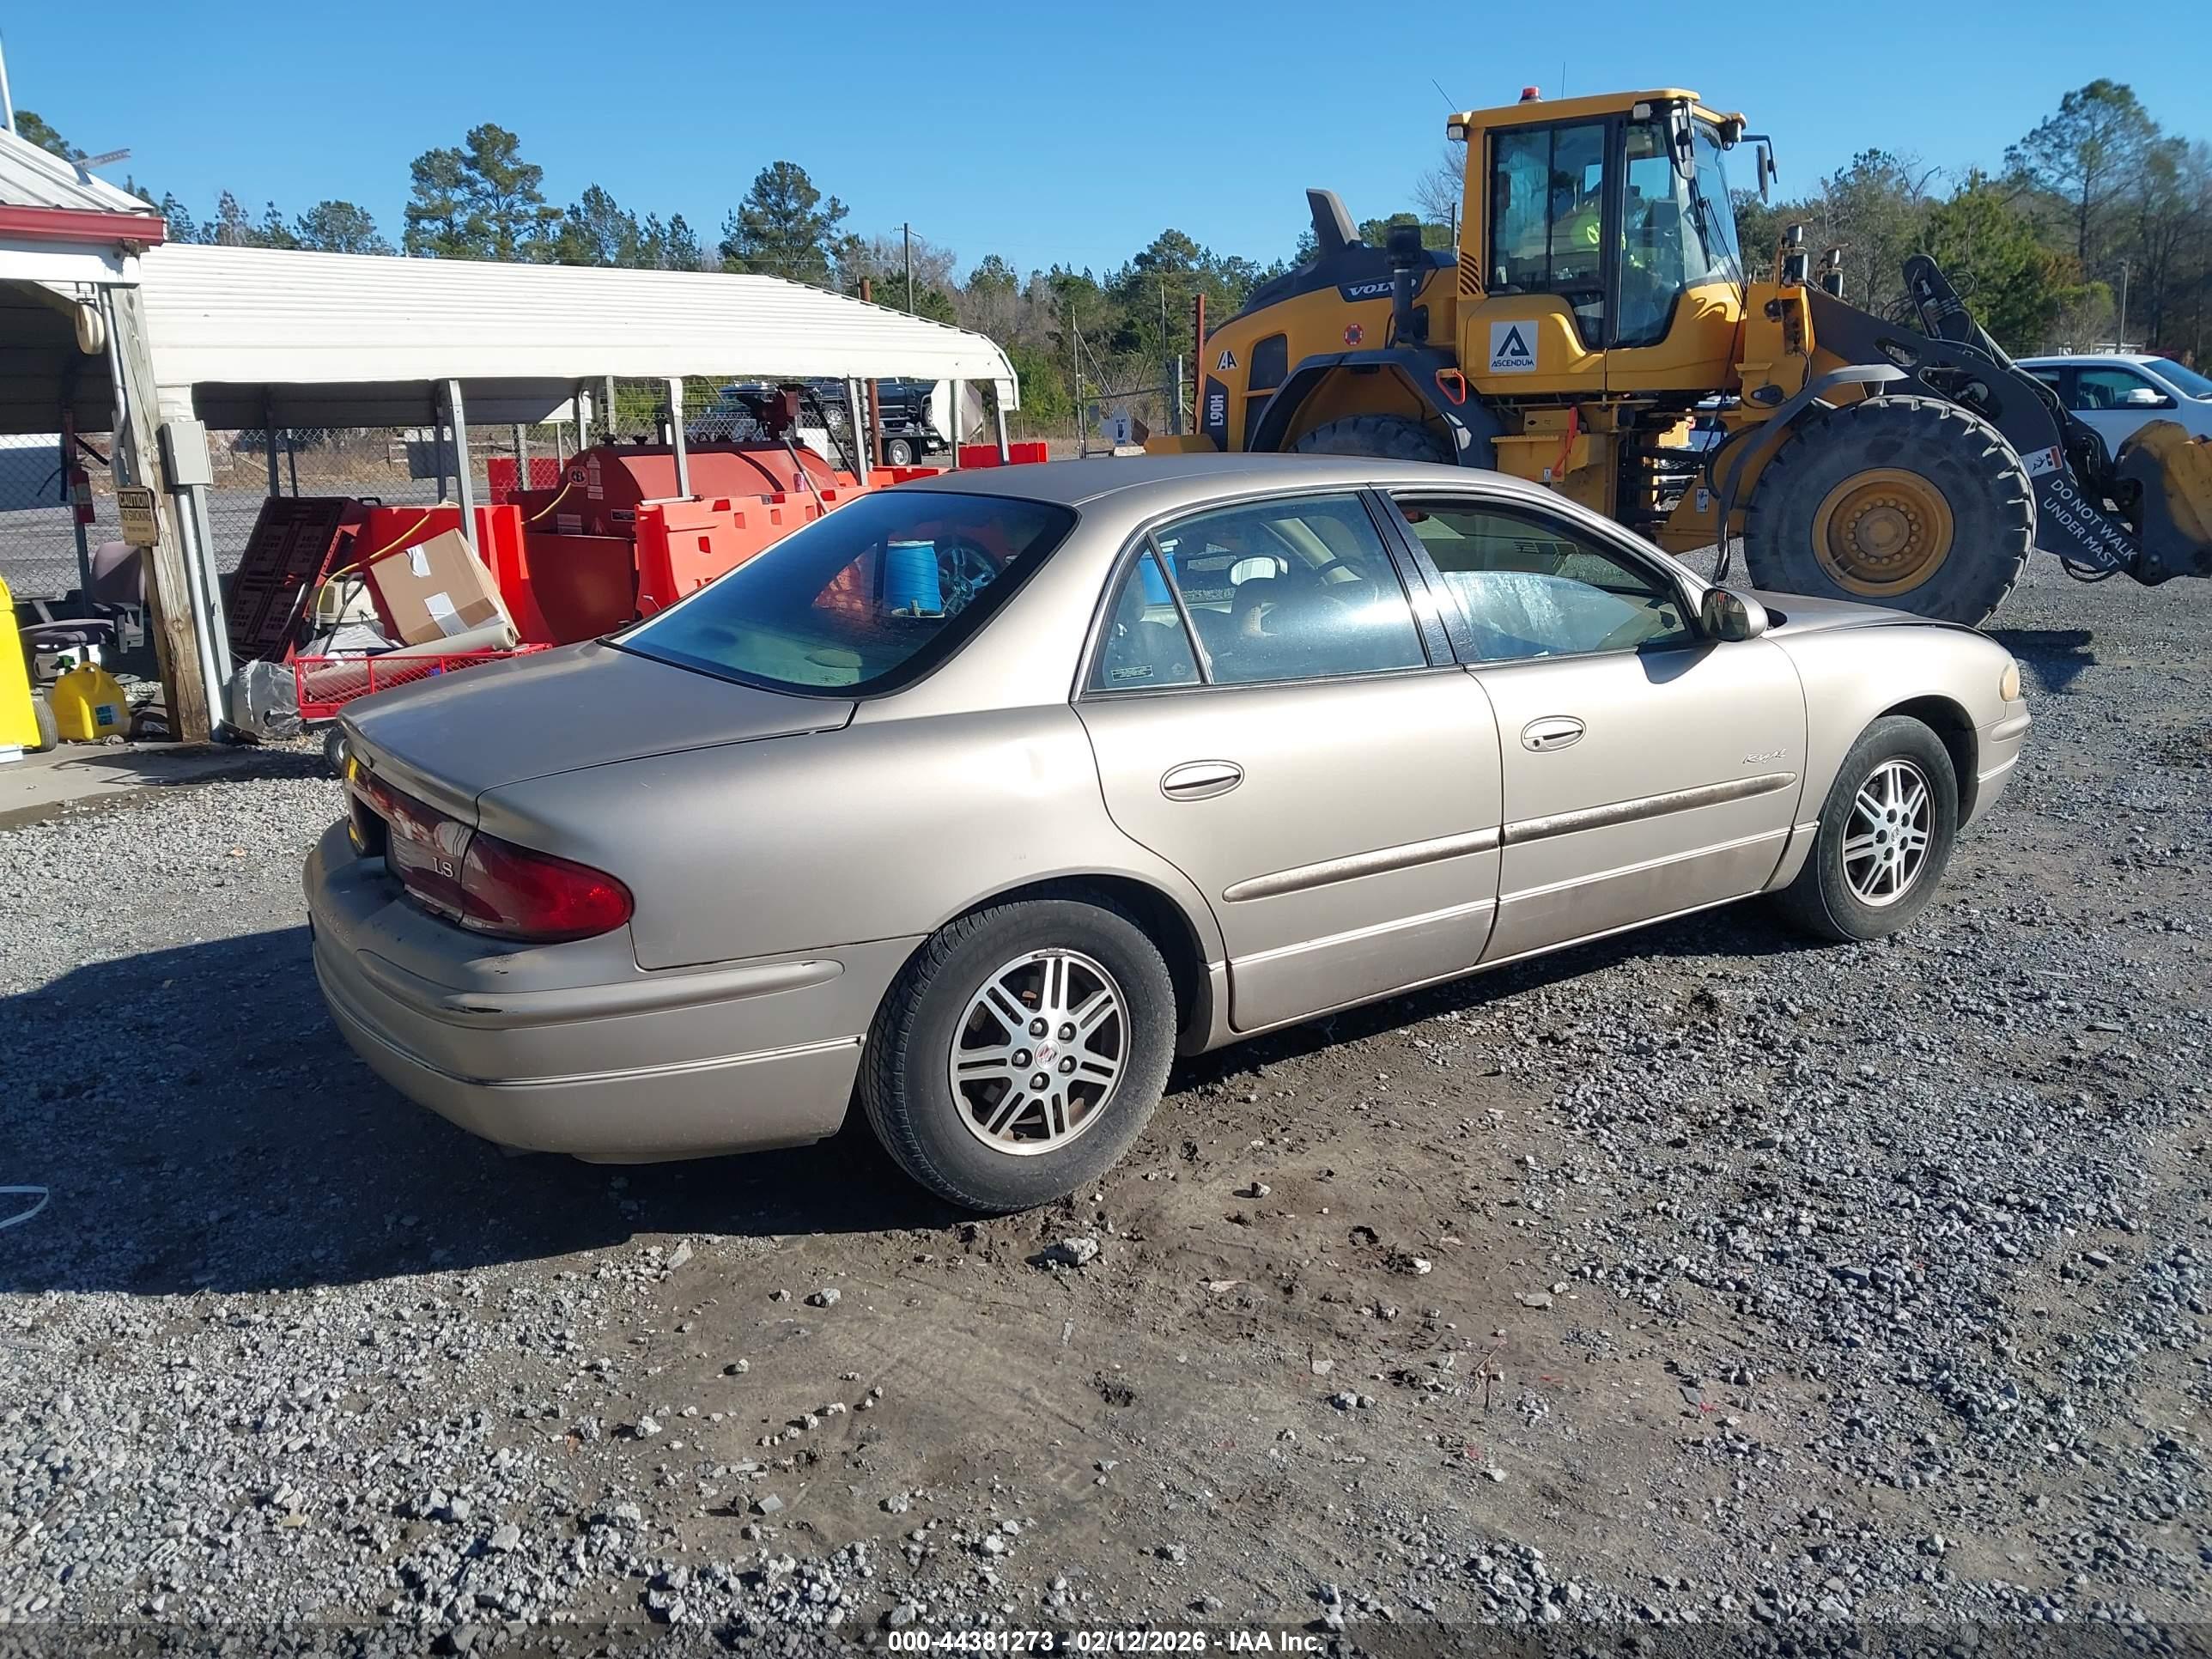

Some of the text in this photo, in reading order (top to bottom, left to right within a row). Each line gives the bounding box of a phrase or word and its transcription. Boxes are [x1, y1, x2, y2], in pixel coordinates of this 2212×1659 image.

[1491, 359, 1534, 368] ASCENDUM
[1210, 394, 1224, 426] L90H
[118, 493, 149, 507] CAUTION
[2044, 497, 2120, 567] UNDER MAST
[2051, 479, 2138, 561] DO NOT WALK
[432, 856, 454, 878] LS
